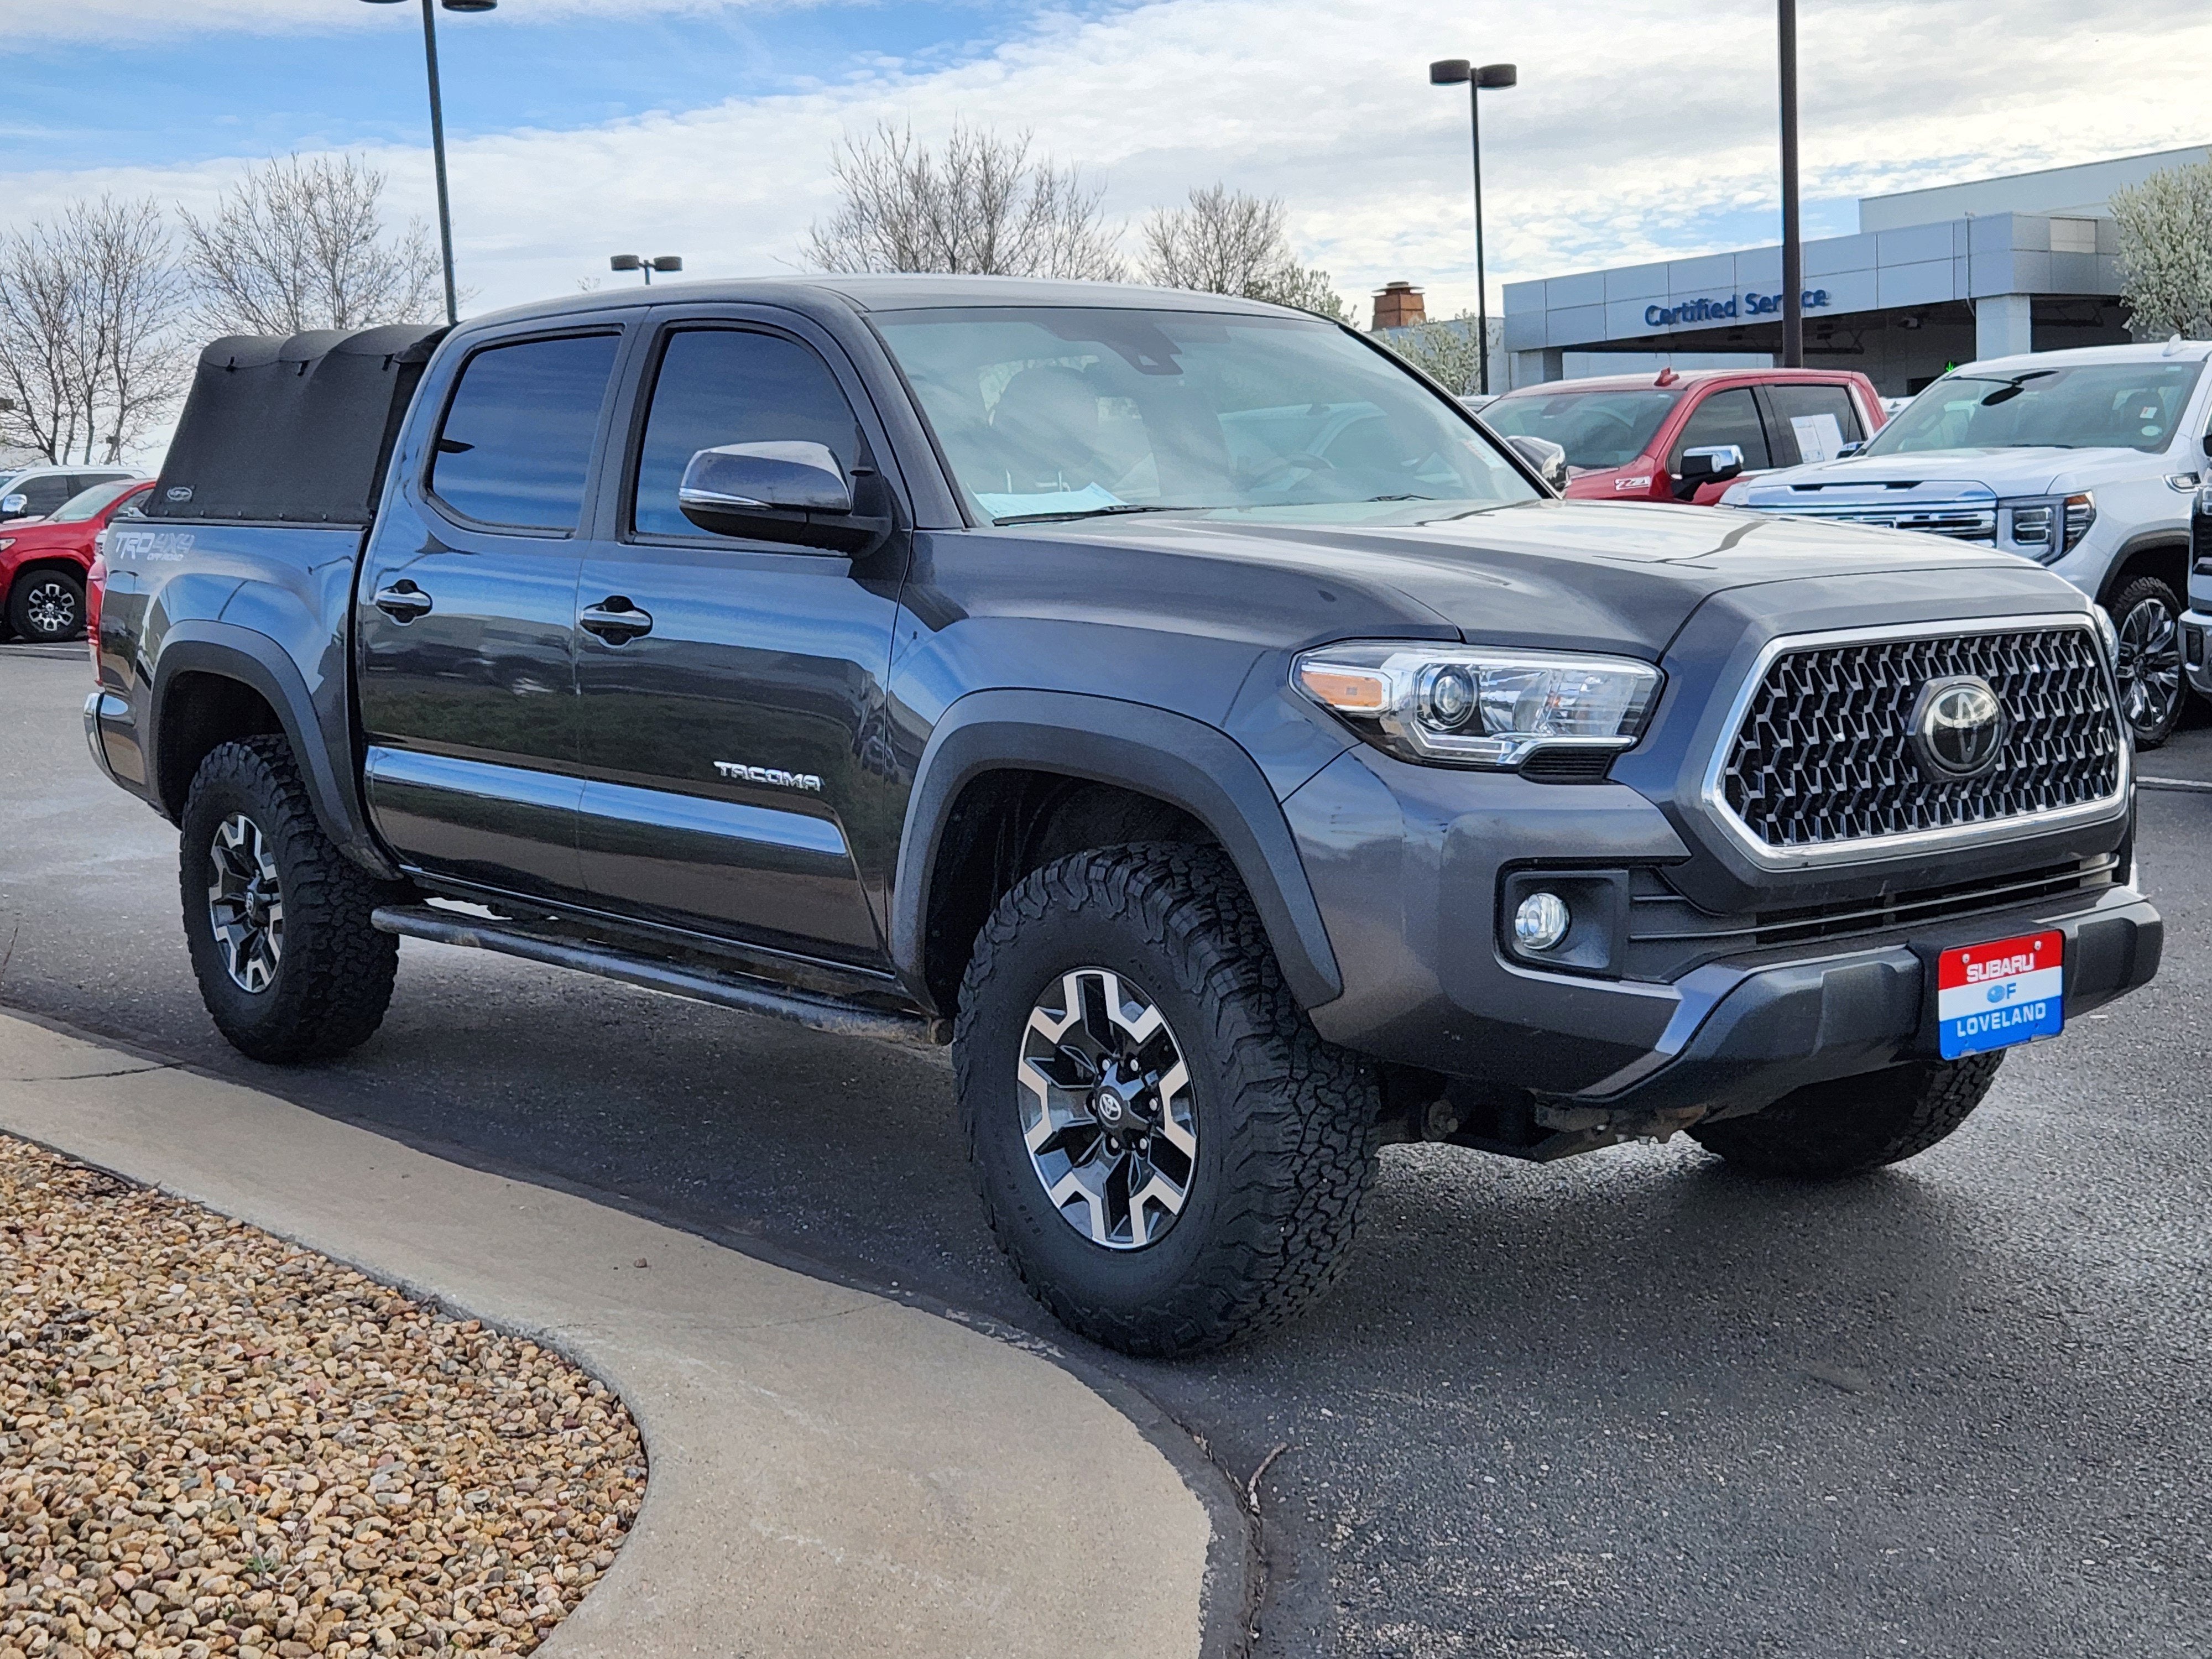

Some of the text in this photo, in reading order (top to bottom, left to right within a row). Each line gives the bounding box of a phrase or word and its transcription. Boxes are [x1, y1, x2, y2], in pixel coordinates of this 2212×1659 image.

[1645, 289, 1830, 326] Certified Serce
[116, 531, 155, 560] TRD
[713, 761, 821, 792] TACOMA
[1966, 952, 2034, 983] SUBARU
[1957, 1002, 2047, 1037] LOVELAND
